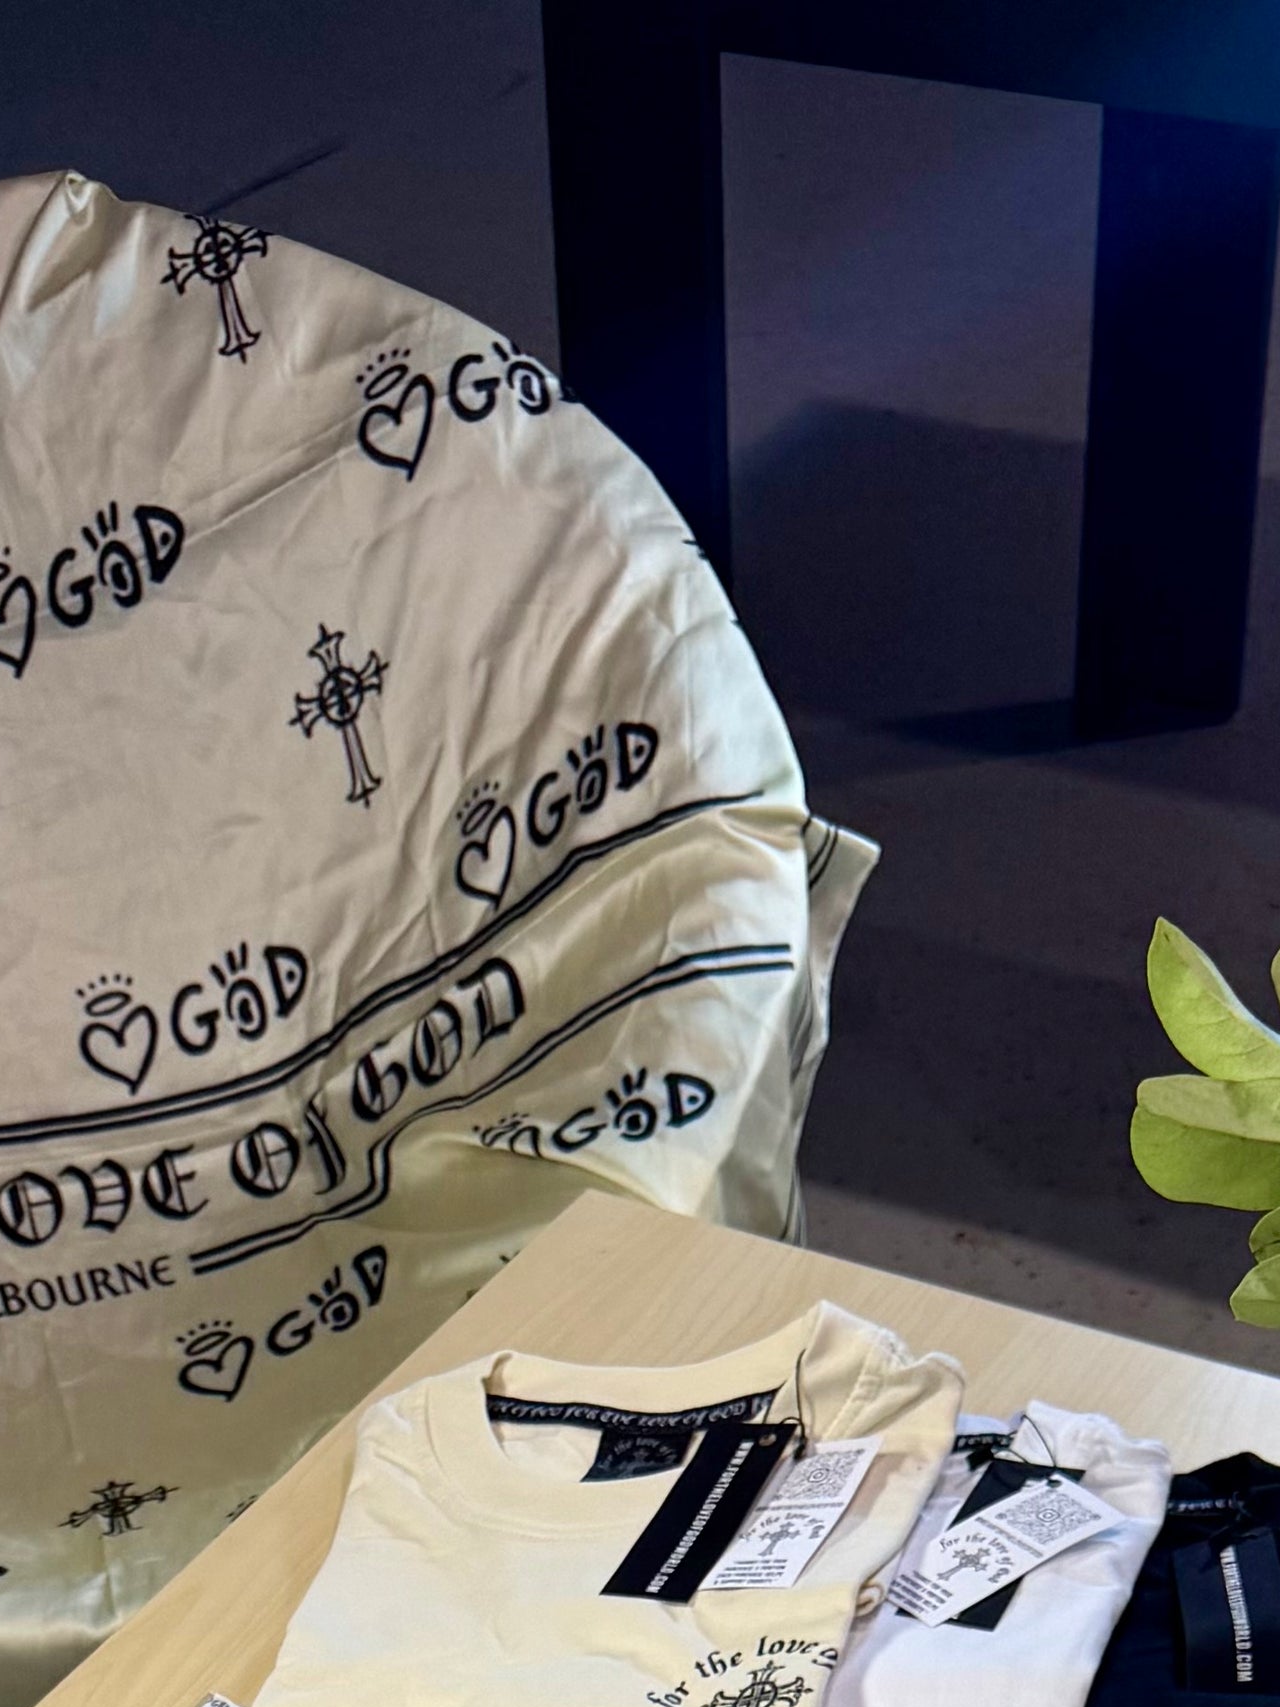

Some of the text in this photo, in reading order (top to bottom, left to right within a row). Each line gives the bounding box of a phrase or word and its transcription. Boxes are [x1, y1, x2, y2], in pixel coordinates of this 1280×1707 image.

[449, 341, 586, 422] GO
[47, 501, 185, 628] GOD
[527, 724, 658, 847] GOD
[170, 941, 308, 1058] GOD
[349, 957, 526, 1124] GOD
[552, 1069, 716, 1157] GOD
[265, 1243, 389, 1358] GOD
[694, 1649, 742, 1679] the
[756, 1636, 819, 1657] love
